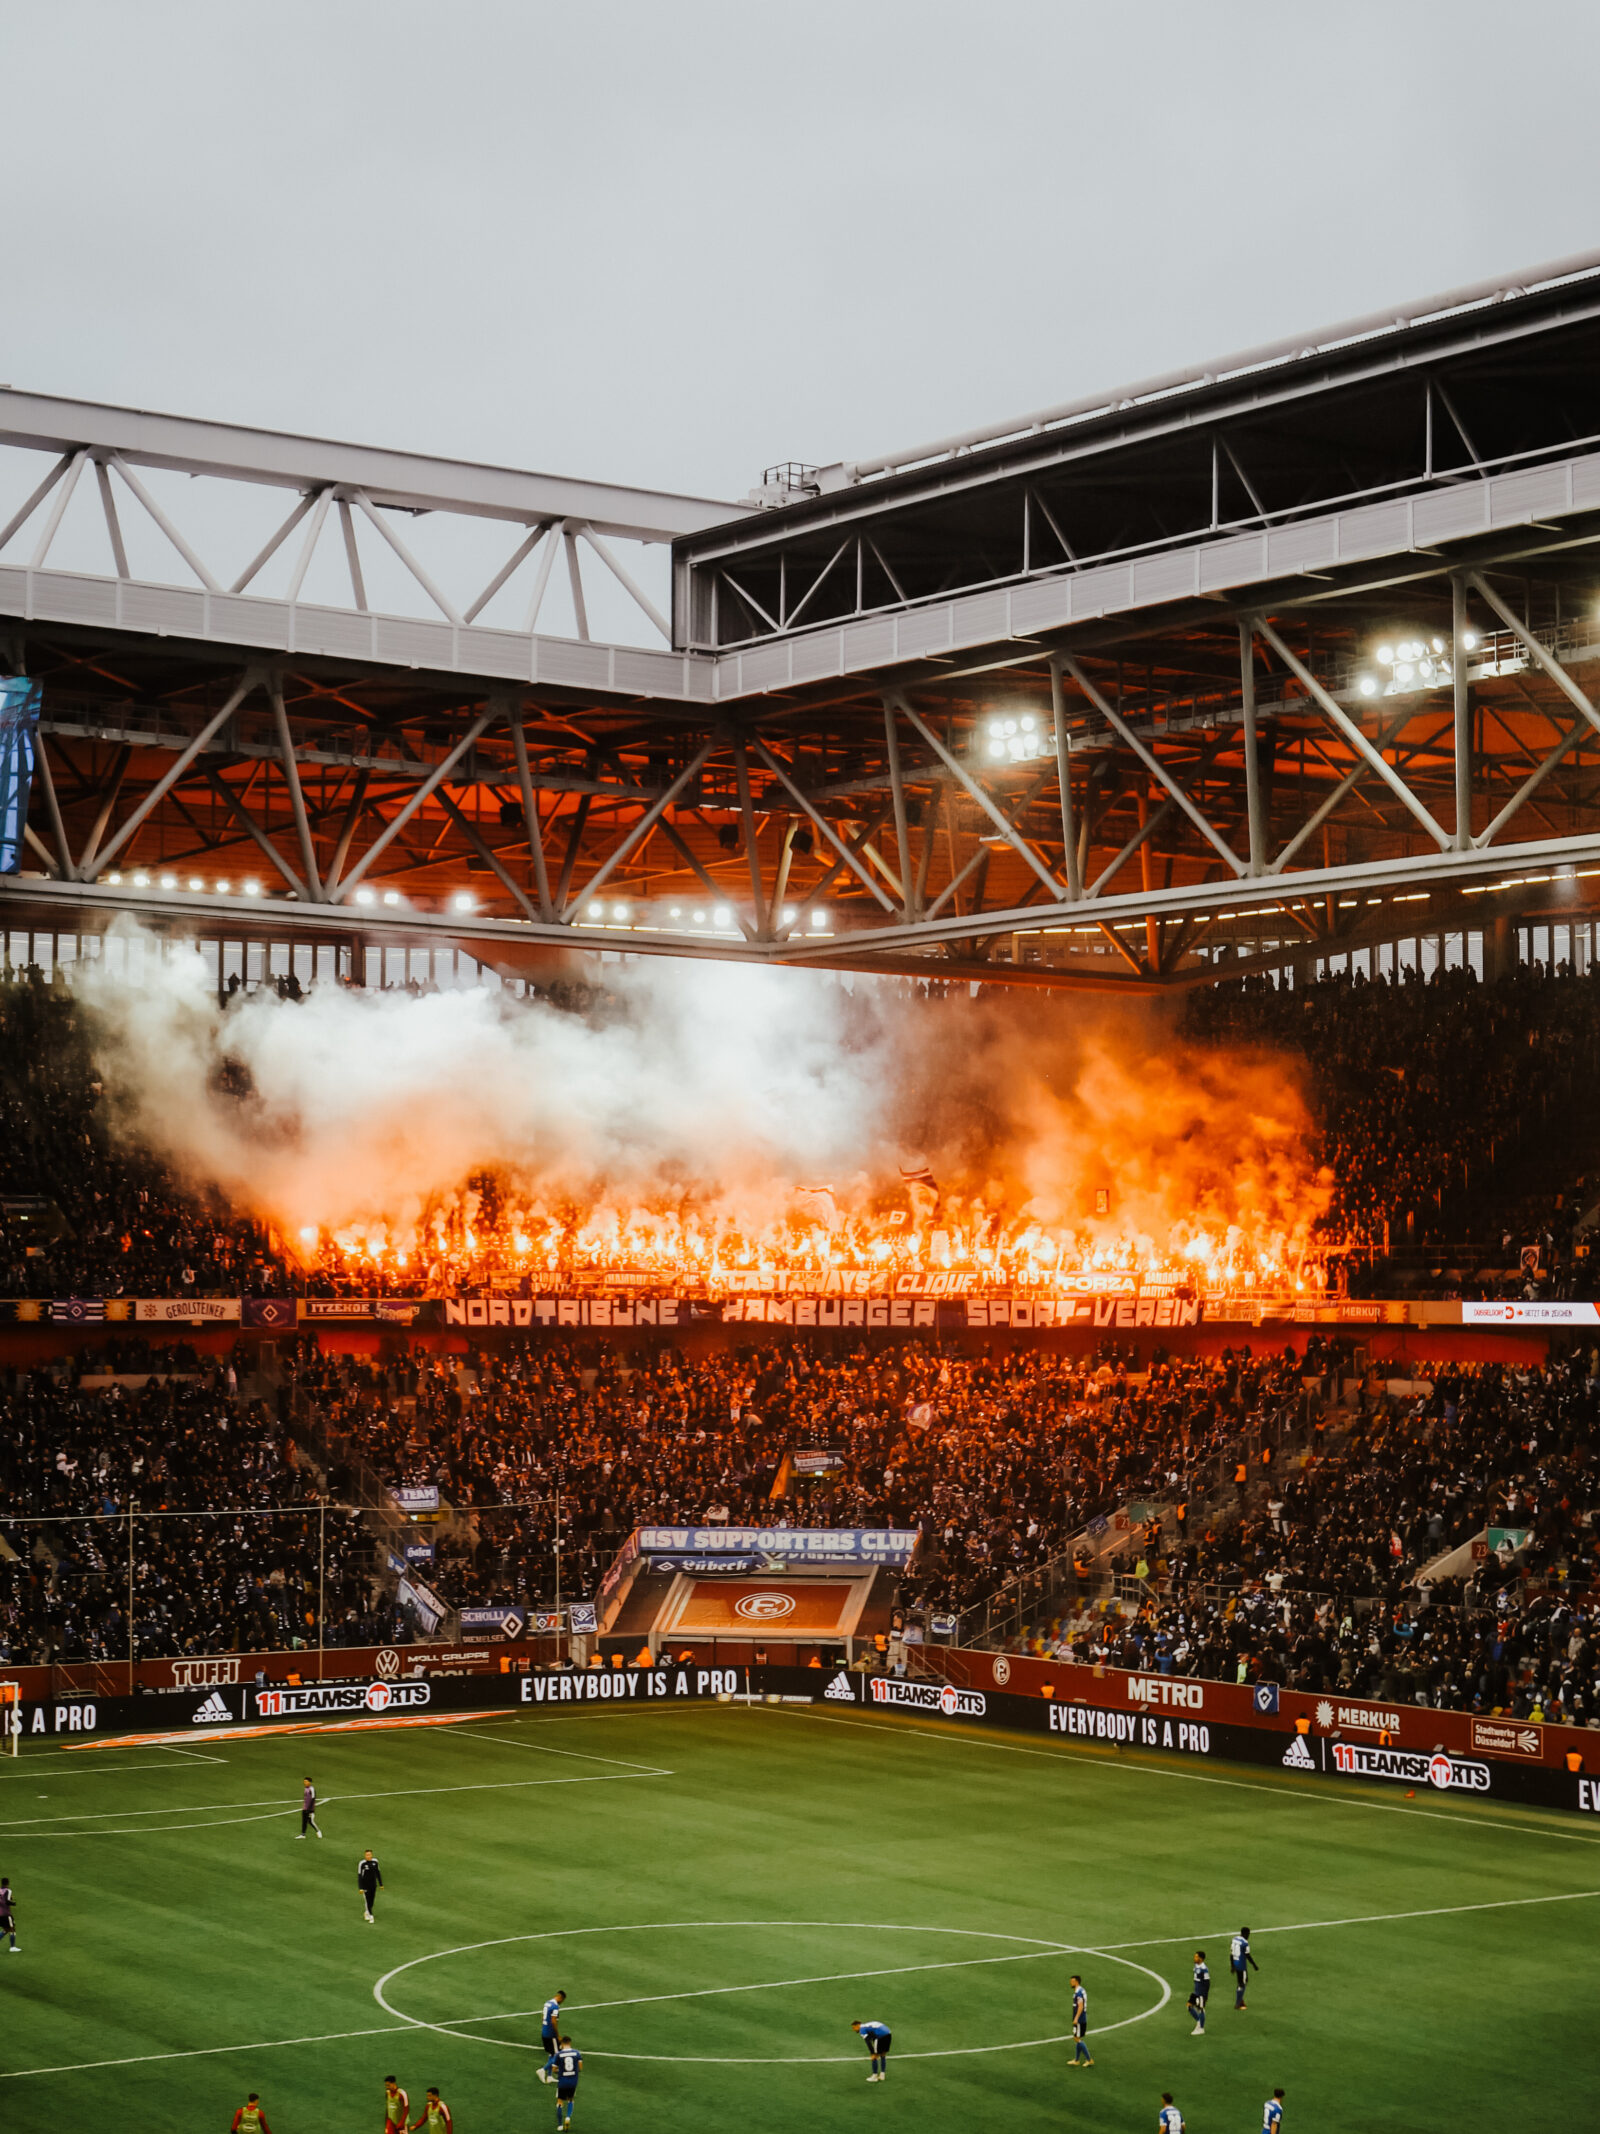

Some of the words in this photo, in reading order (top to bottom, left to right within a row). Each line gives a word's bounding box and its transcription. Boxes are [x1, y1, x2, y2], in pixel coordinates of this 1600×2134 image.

[896, 1273, 978, 1293] CLIQUE
[1064, 1276, 1136, 1292] FORZA
[165, 1302, 226, 1318] GEROLSTEINER
[311, 1304, 370, 1312] ITZEHOE
[722, 1299, 936, 1326] HAMBURGER
[967, 1299, 1198, 1327] SPORT-VEREIN
[1342, 1306, 1381, 1318] MERKUR
[403, 1488, 435, 1499] TEAM
[640, 1530, 689, 1548] HSV
[694, 1531, 855, 1551] SUPPORTERS
[681, 1559, 748, 1571] Lübeck
[460, 1610, 505, 1622] SCHOLLI
[441, 1651, 489, 1661] GRUPPE
[171, 1659, 241, 1687] TUFFI
[520, 1672, 640, 1702] EVERYBODY
[647, 1672, 667, 1696] IS
[675, 1671, 689, 1695] A
[697, 1669, 737, 1694] PRO
[1127, 1676, 1204, 1710] METRO
[824, 1688, 856, 1702] adidas
[31, 1707, 46, 1733] A
[55, 1704, 97, 1732] PRO
[192, 1711, 233, 1724] adidas
[1338, 1706, 1400, 1731] MERKUR
[1049, 1703, 1136, 1742] EVERYBODY
[1142, 1717, 1157, 1746] IS
[1162, 1720, 1174, 1748] A
[1178, 1722, 1210, 1753] PRO
[1475, 1724, 1516, 1738] Stadtwerke
[1475, 1734, 1516, 1749] Düsseldorf
[1282, 1754, 1316, 1770] adidas
[564, 2057, 574, 2072] 8
